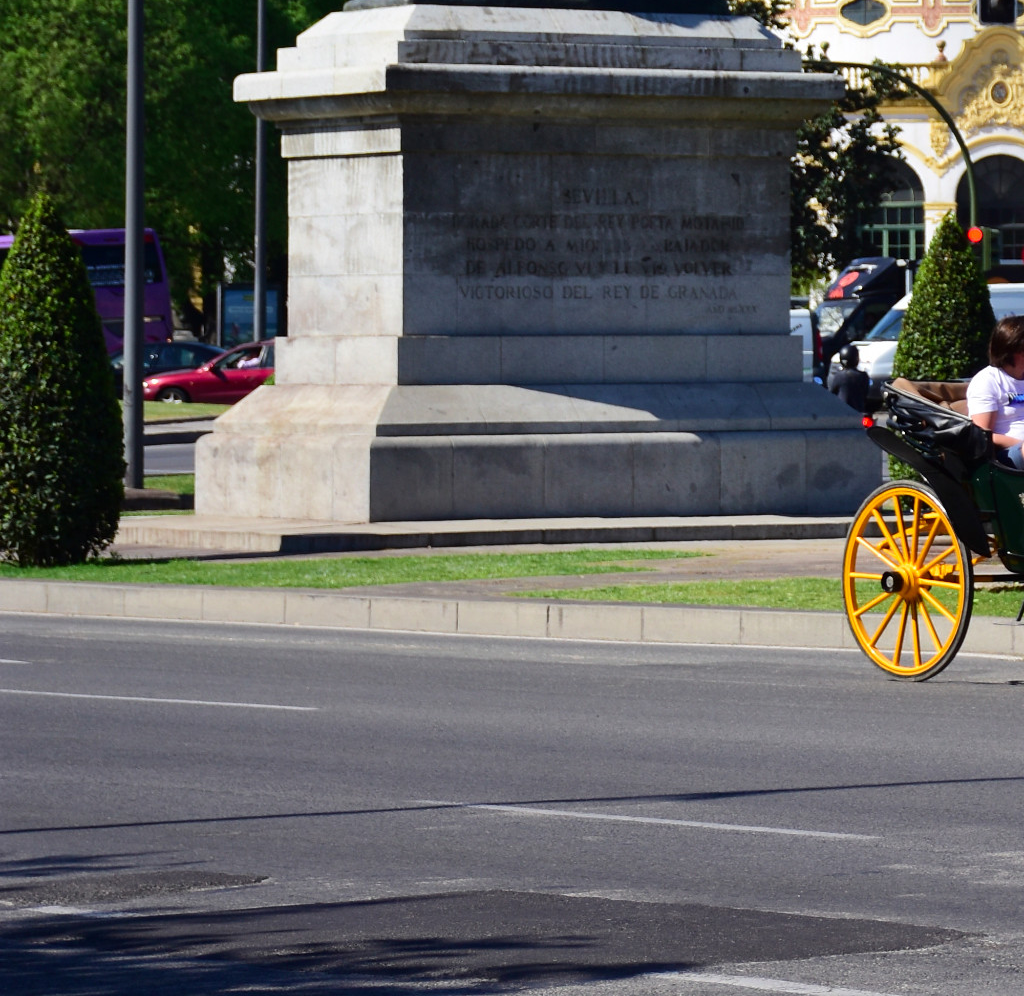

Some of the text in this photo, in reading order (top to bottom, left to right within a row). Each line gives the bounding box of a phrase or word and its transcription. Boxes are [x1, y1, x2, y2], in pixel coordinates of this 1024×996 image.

[459, 285, 739, 301] VICTORIOSO DEL REY DE GRANADA
